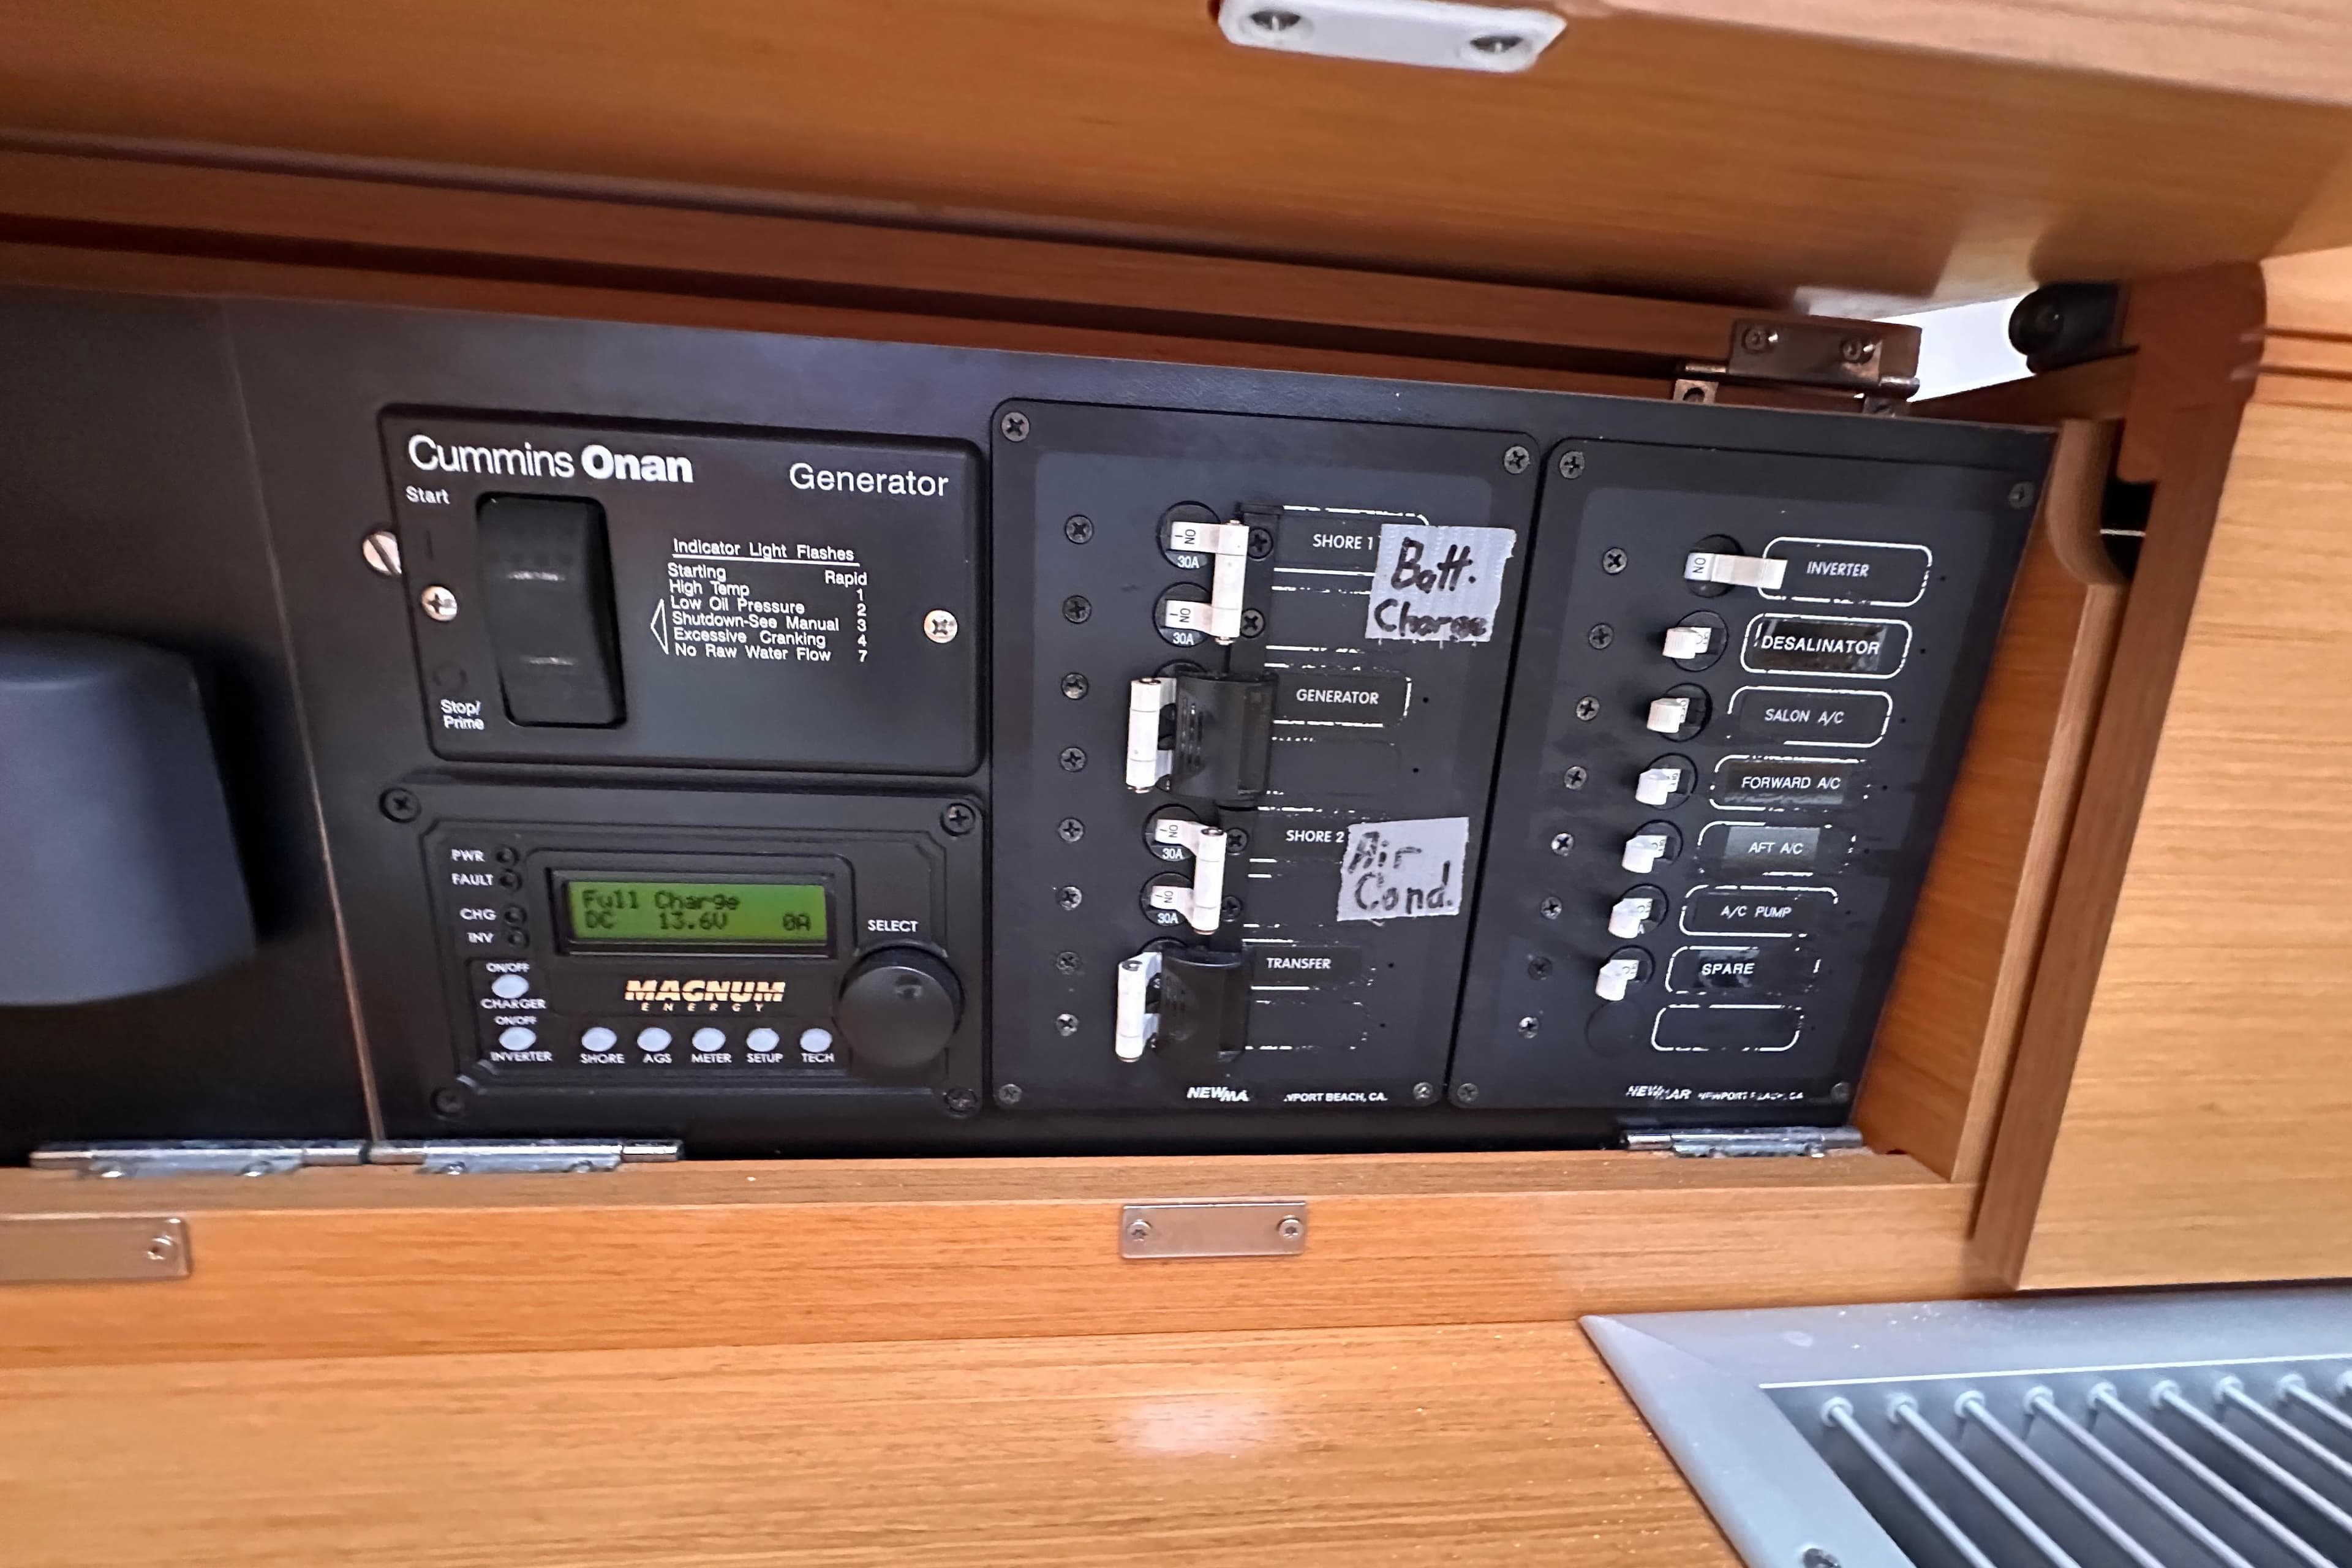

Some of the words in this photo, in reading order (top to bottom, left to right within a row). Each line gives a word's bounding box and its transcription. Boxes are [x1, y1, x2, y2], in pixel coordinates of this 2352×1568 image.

[409, 434, 575, 478] Cummins
[581, 444, 693, 483] Onan
[790, 462, 949, 496] Generator
[405, 486, 450, 505] Start
[1313, 533, 1363, 549] SHORE
[1366, 536, 1374, 550] 1
[673, 538, 741, 556] Indicator
[748, 541, 788, 559] Light
[796, 544, 854, 562] Flashes
[1177, 555, 1200, 569] 30A
[1391, 537, 1476, 594] Batt.
[1806, 560, 1870, 578] INVERTER
[668, 562, 726, 582] Starting
[824, 570, 867, 587] Rapid
[669, 579, 703, 598] High
[709, 581, 750, 599] Temp
[856, 588, 864, 600] 1
[670, 595, 702, 610] Low
[709, 597, 729, 611] Oil
[737, 598, 805, 615] Pressure
[857, 603, 867, 617] 2
[673, 611, 778, 629] Shutdown-See
[786, 616, 839, 631] Manual
[857, 618, 867, 632] 3
[1374, 598, 1487, 642] Charge
[674, 627, 747, 644] Excessive
[759, 631, 826, 649] Cranking
[857, 634, 867, 647] 4
[1172, 631, 1195, 646] 30A
[1760, 633, 1882, 655] DESALINATOR
[675, 643, 697, 657] No
[705, 644, 737, 658] Raw
[745, 645, 788, 660] Water
[796, 646, 832, 662] Flow
[858, 649, 868, 663] 7
[1295, 688, 1379, 705] GENERATOR
[440, 699, 481, 715] Stop/
[443, 715, 484, 730] Prime
[1764, 708, 1811, 723] SALON
[1817, 710, 1845, 726] A/C
[1741, 776, 1811, 790] FORWARD
[1817, 776, 1842, 790] A/C
[1285, 829, 1332, 843] SHORE
[1335, 831, 1345, 844] 2
[451, 849, 485, 862] PWR
[1162, 848, 1184, 861] 30A
[1748, 842, 1775, 854] AFT
[1779, 842, 1804, 855] A/C
[451, 873, 494, 886] FAULT
[582, 889, 640, 910] Full
[654, 890, 741, 911] Charge
[459, 908, 497, 921] CHG
[1157, 912, 1179, 924] 30A
[1720, 905, 1747, 919] A/C
[1754, 906, 1792, 918] PUMP
[584, 910, 616, 930] DC
[659, 911, 729, 930] 13.6V
[867, 919, 919, 933] SELECT
[467, 932, 494, 943] INV
[485, 962, 530, 973] ON/OFF
[1265, 957, 1332, 970] TRANSFER
[1700, 963, 1755, 976] SPARE
[624, 979, 786, 1002] MAGNUM
[480, 998, 547, 1009] CHARGER
[640, 1003, 764, 1012] ENERGY
[494, 1015, 537, 1025] ON/OFF
[490, 1051, 553, 1062] INVERTER
[580, 1052, 625, 1065] SHORE
[643, 1052, 673, 1065] AGS
[691, 1052, 732, 1064] METER
[746, 1052, 784, 1064] SETUP
[801, 1052, 835, 1064] TECH
[1186, 1087, 1250, 1102] NEWMA
